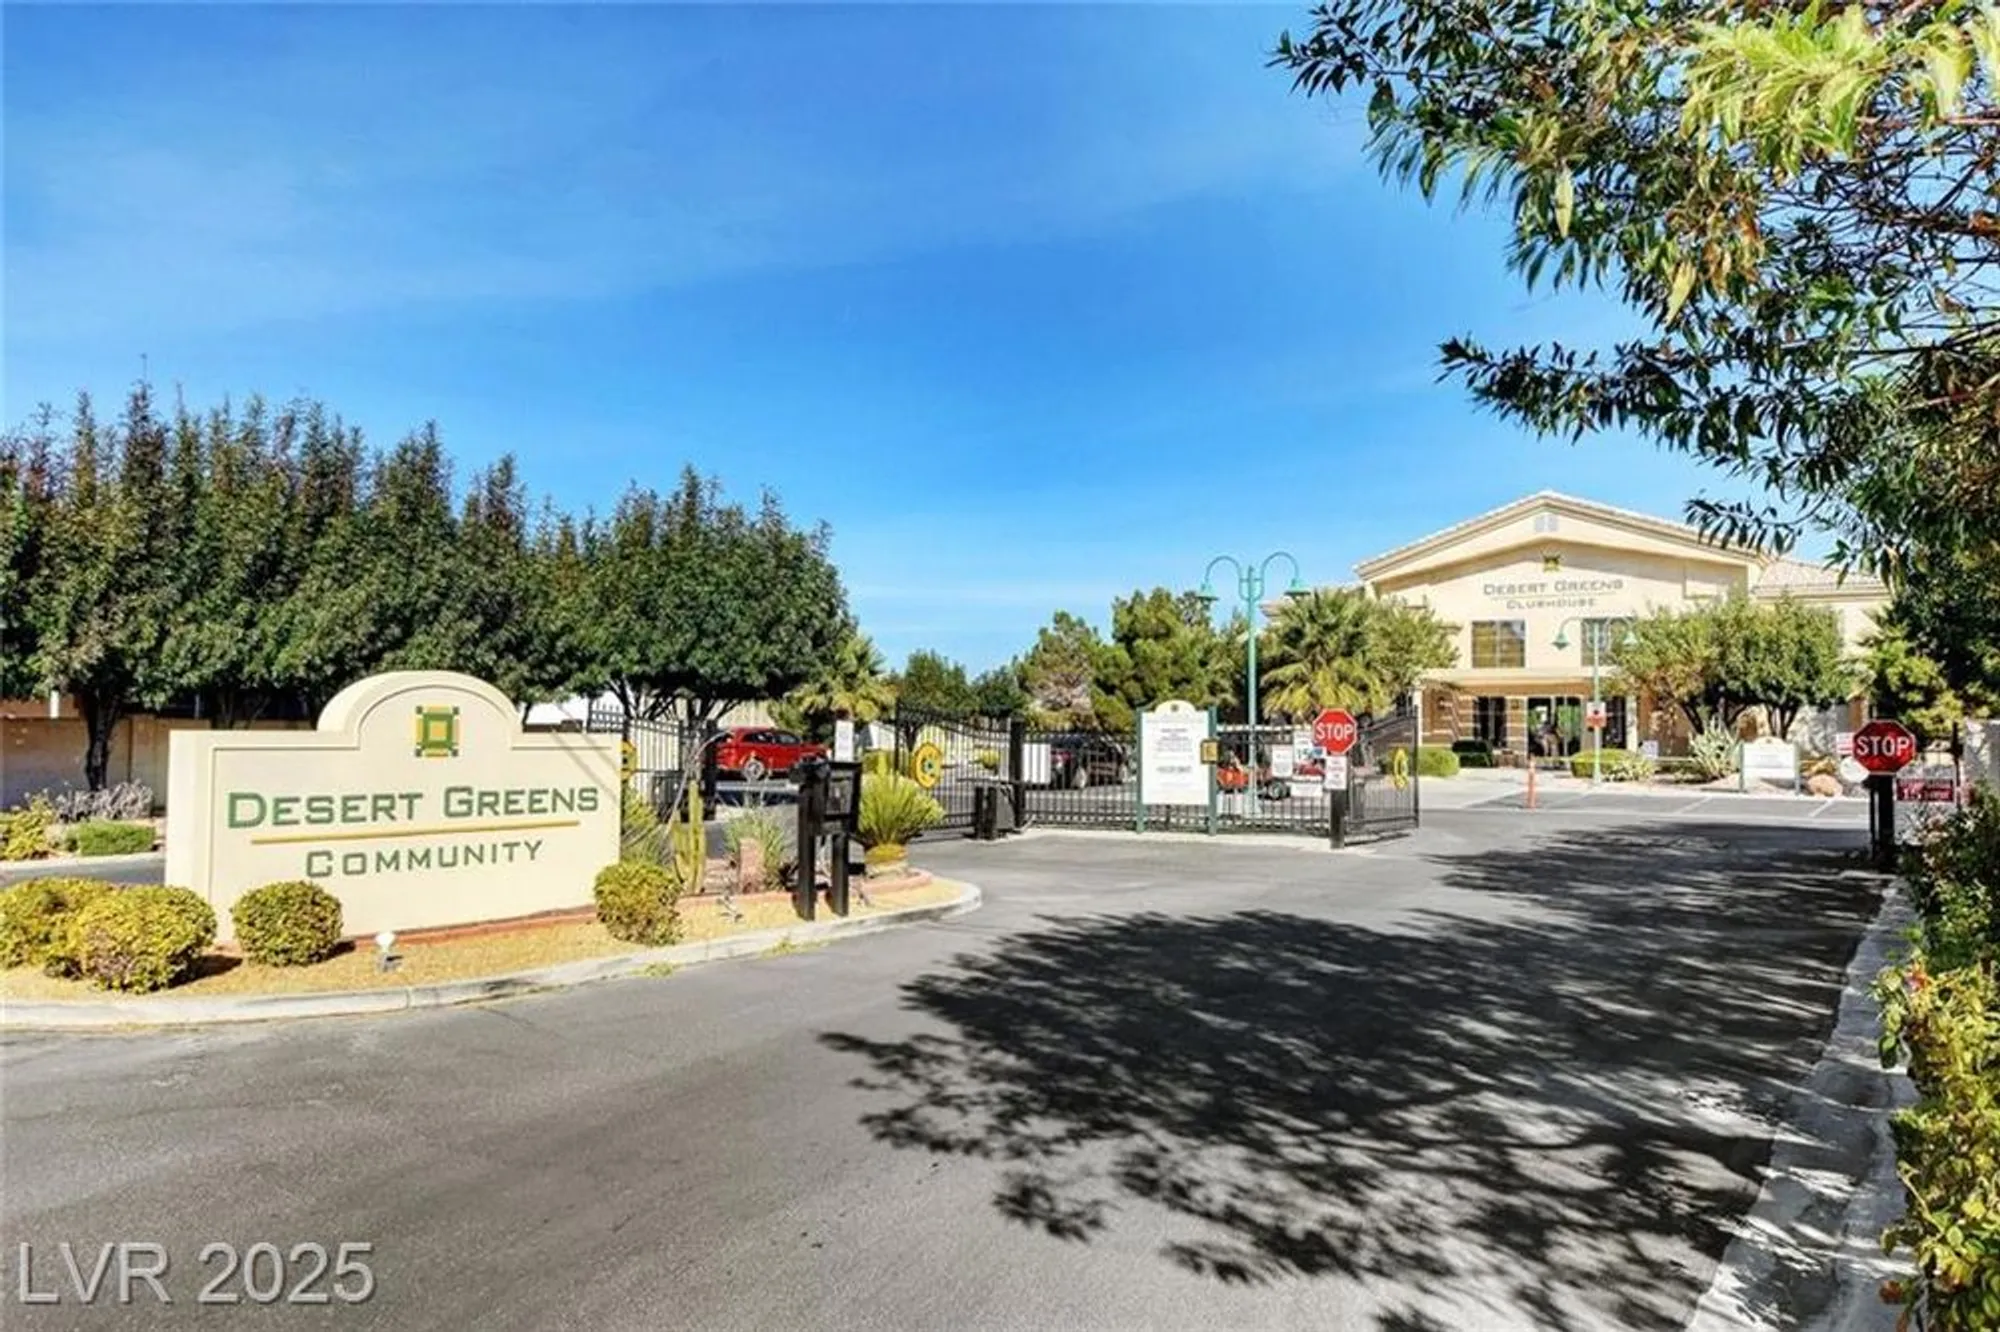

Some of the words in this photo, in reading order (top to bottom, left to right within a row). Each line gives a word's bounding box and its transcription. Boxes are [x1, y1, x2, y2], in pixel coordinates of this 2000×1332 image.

[1483, 581, 1548, 596] DESERT
[1554, 578, 1624, 593] GREENS
[1315, 722, 1354, 741] STOP
[1856, 736, 1911, 757] STOP
[227, 791, 423, 829] DESERT
[443, 785, 599, 818] GREENS
[305, 840, 544, 879] COMMUNITY
